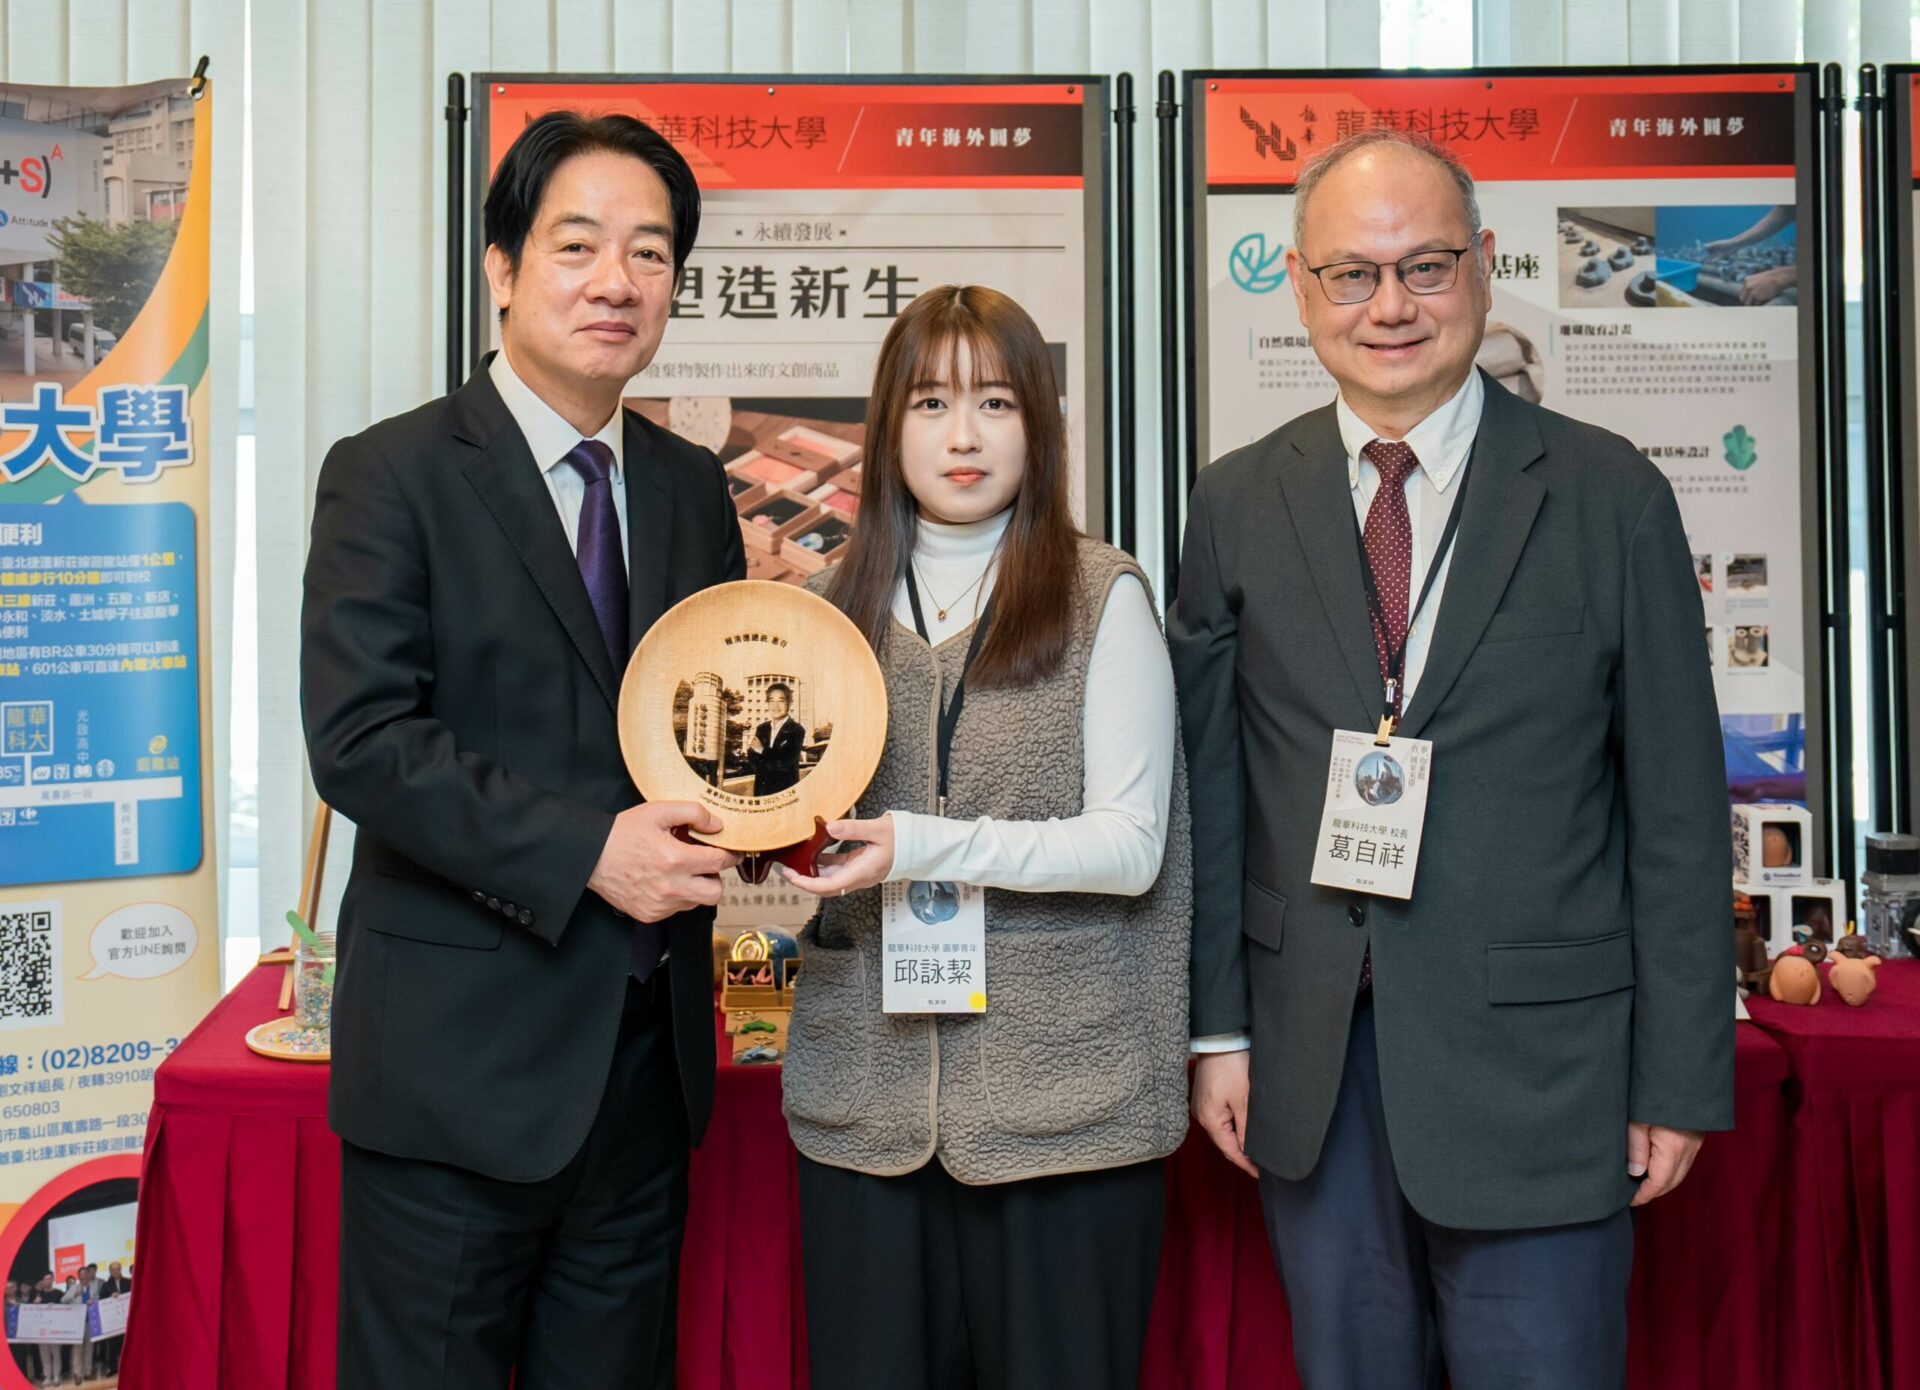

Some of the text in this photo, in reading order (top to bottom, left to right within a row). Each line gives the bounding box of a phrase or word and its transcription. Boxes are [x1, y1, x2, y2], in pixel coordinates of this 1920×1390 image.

[637, 113, 827, 150] 華科技大學
[1608, 116, 1745, 138] 青年海外圓夢
[896, 127, 1033, 148] 青年海外圓夢
[752, 222, 833, 242] 永續發展
[637, 361, 840, 380] 廢棄物製作出來的文創商品
[2, 386, 190, 479] 大學
[0, 570, 152, 587] 鐘或步行10分鐘即可到校
[0, 590, 179, 608] 三線新莊、蘆洲、五股、新店、
[0, 604, 179, 623] 永和、淡水、土城學子往返龍華
[0, 625, 28, 639] 便利
[0, 640, 179, 660] 地區有BR公車30分鐘可以到達
[1332, 817, 1408, 839] 龍華科技大學 校長
[1328, 833, 1406, 870] 葛自祥
[120, 924, 173, 941] 歡迎加入
[887, 943, 939, 953] 龍華科技大學
[3, 1100, 61, 1120] 650803
[0, 1111, 149, 1144] 市龜山區萬壽路一段30
